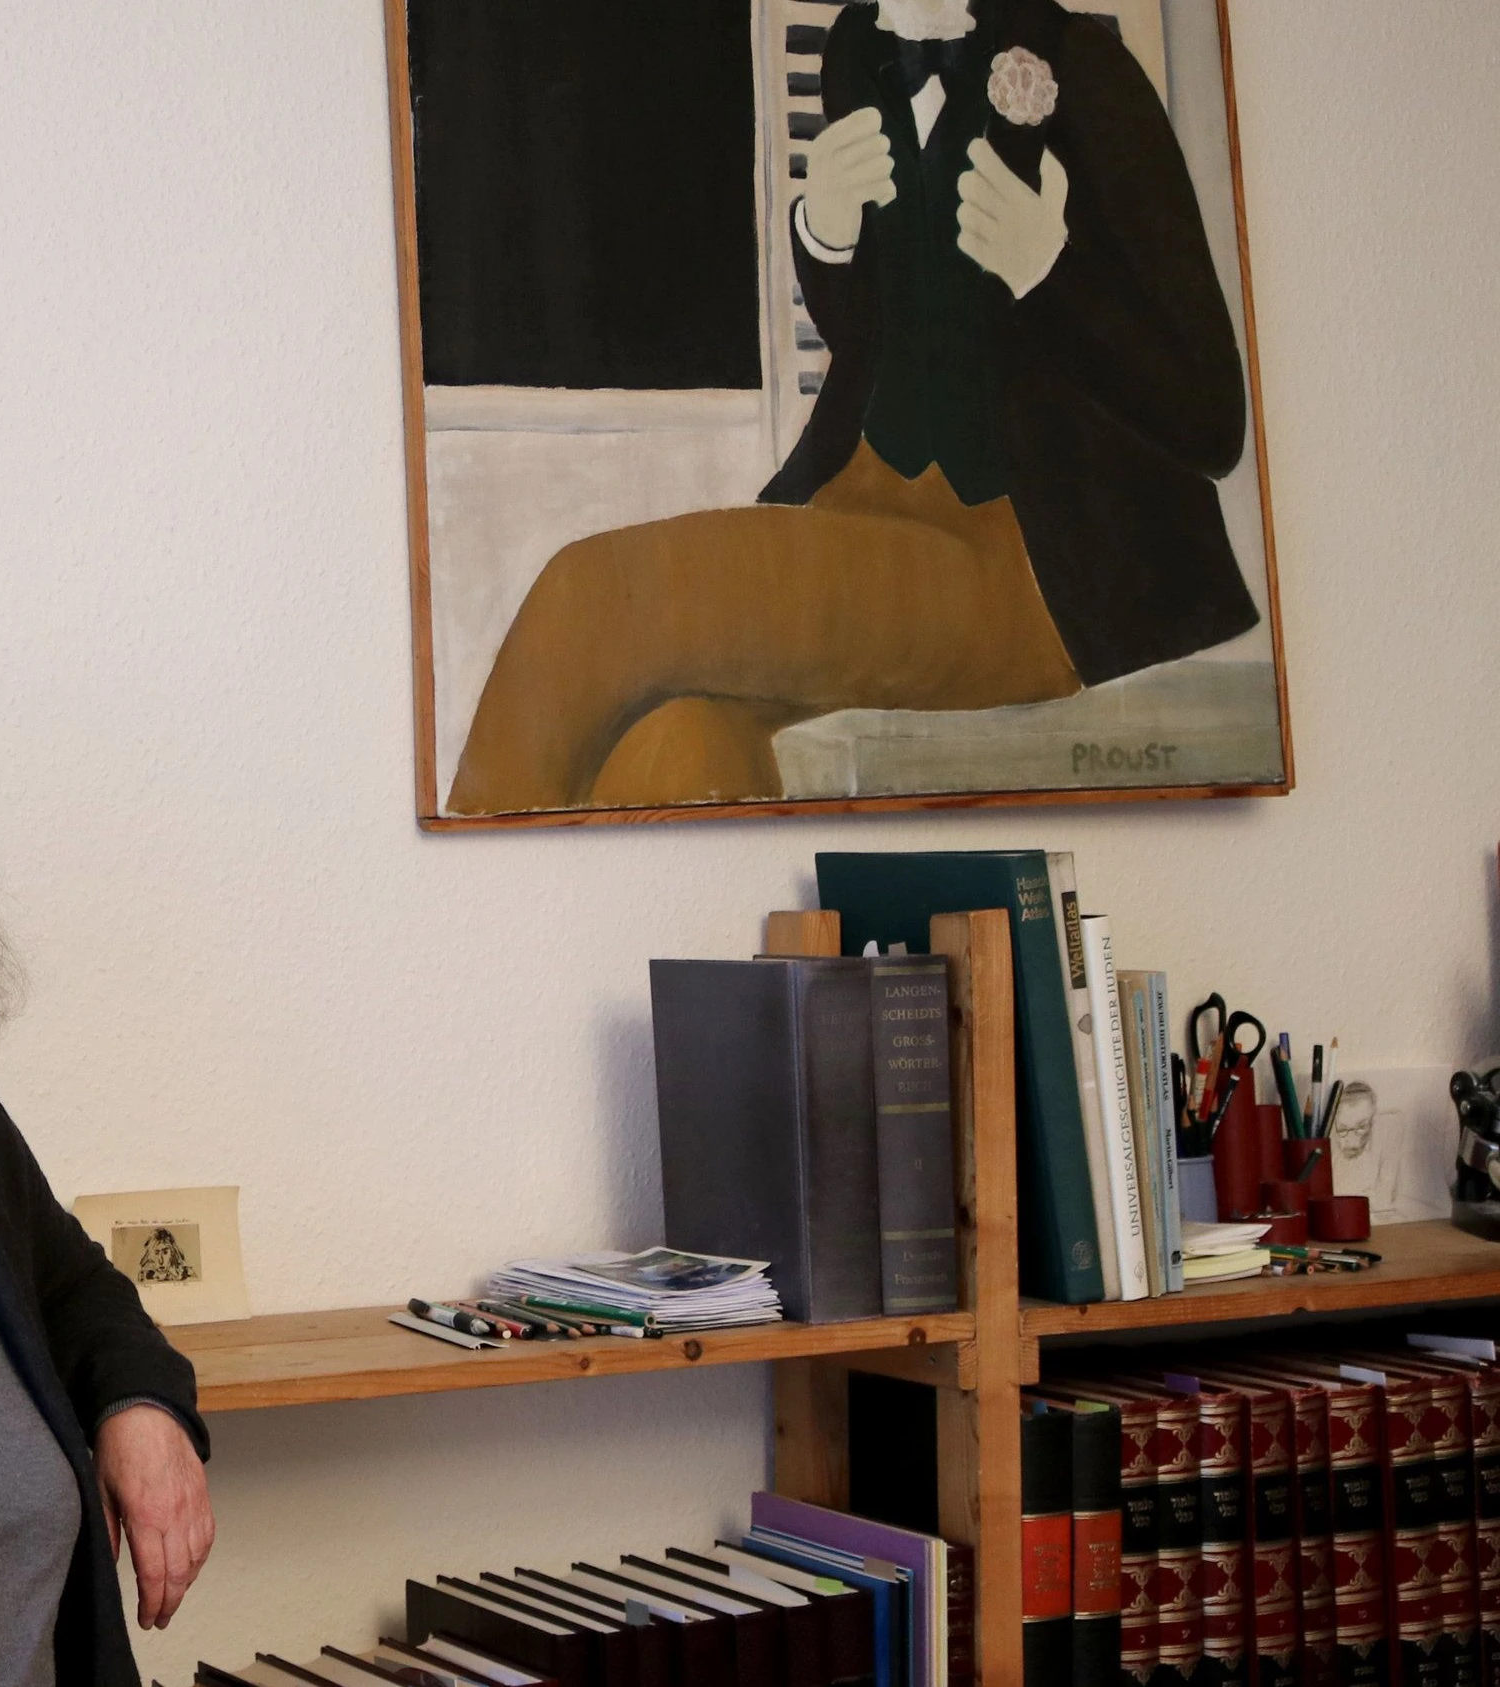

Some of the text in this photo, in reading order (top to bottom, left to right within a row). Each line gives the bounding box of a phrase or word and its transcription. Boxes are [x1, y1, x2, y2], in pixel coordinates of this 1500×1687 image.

[1071, 741, 1177, 774] PROUST
[885, 985, 940, 998] LANGEN-
[882, 1007, 942, 1021] SCHEIDTS
[892, 1035, 936, 1048] GROSS-
[1159, 1029, 1167, 1069] HISTORY
[1102, 936, 1140, 1237] UNIVERSALGESCHICHTE DER JUDEN
[1161, 1071, 1169, 1101] ATLAS
